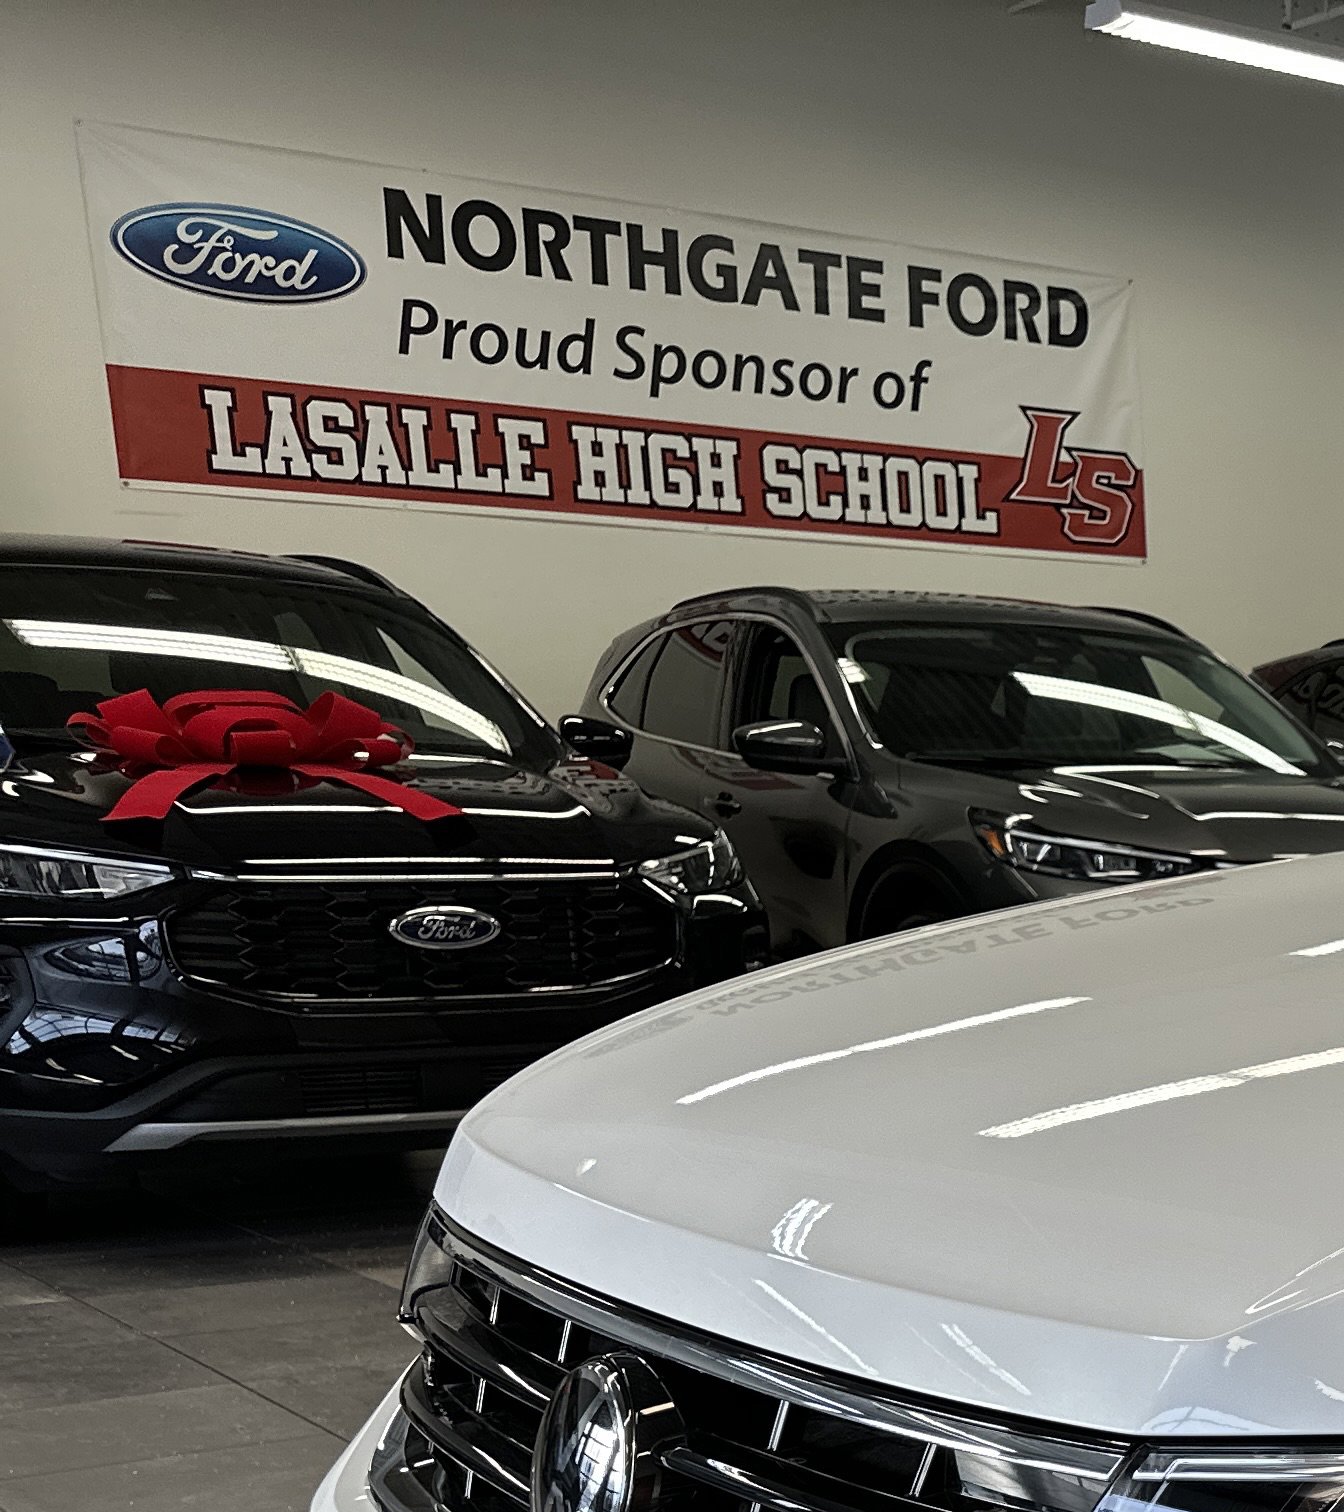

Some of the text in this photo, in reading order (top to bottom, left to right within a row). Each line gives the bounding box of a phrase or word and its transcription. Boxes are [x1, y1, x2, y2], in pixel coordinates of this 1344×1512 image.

[163, 216, 319, 291] Ford
[383, 187, 1089, 348] NORTHGATE FORD
[398, 298, 933, 411] Proud Sponsor of
[200, 383, 1001, 536] LASALLE HIGH SCHOOL
[1003, 405, 1137, 547] LS
[418, 915, 477, 939] Ford
